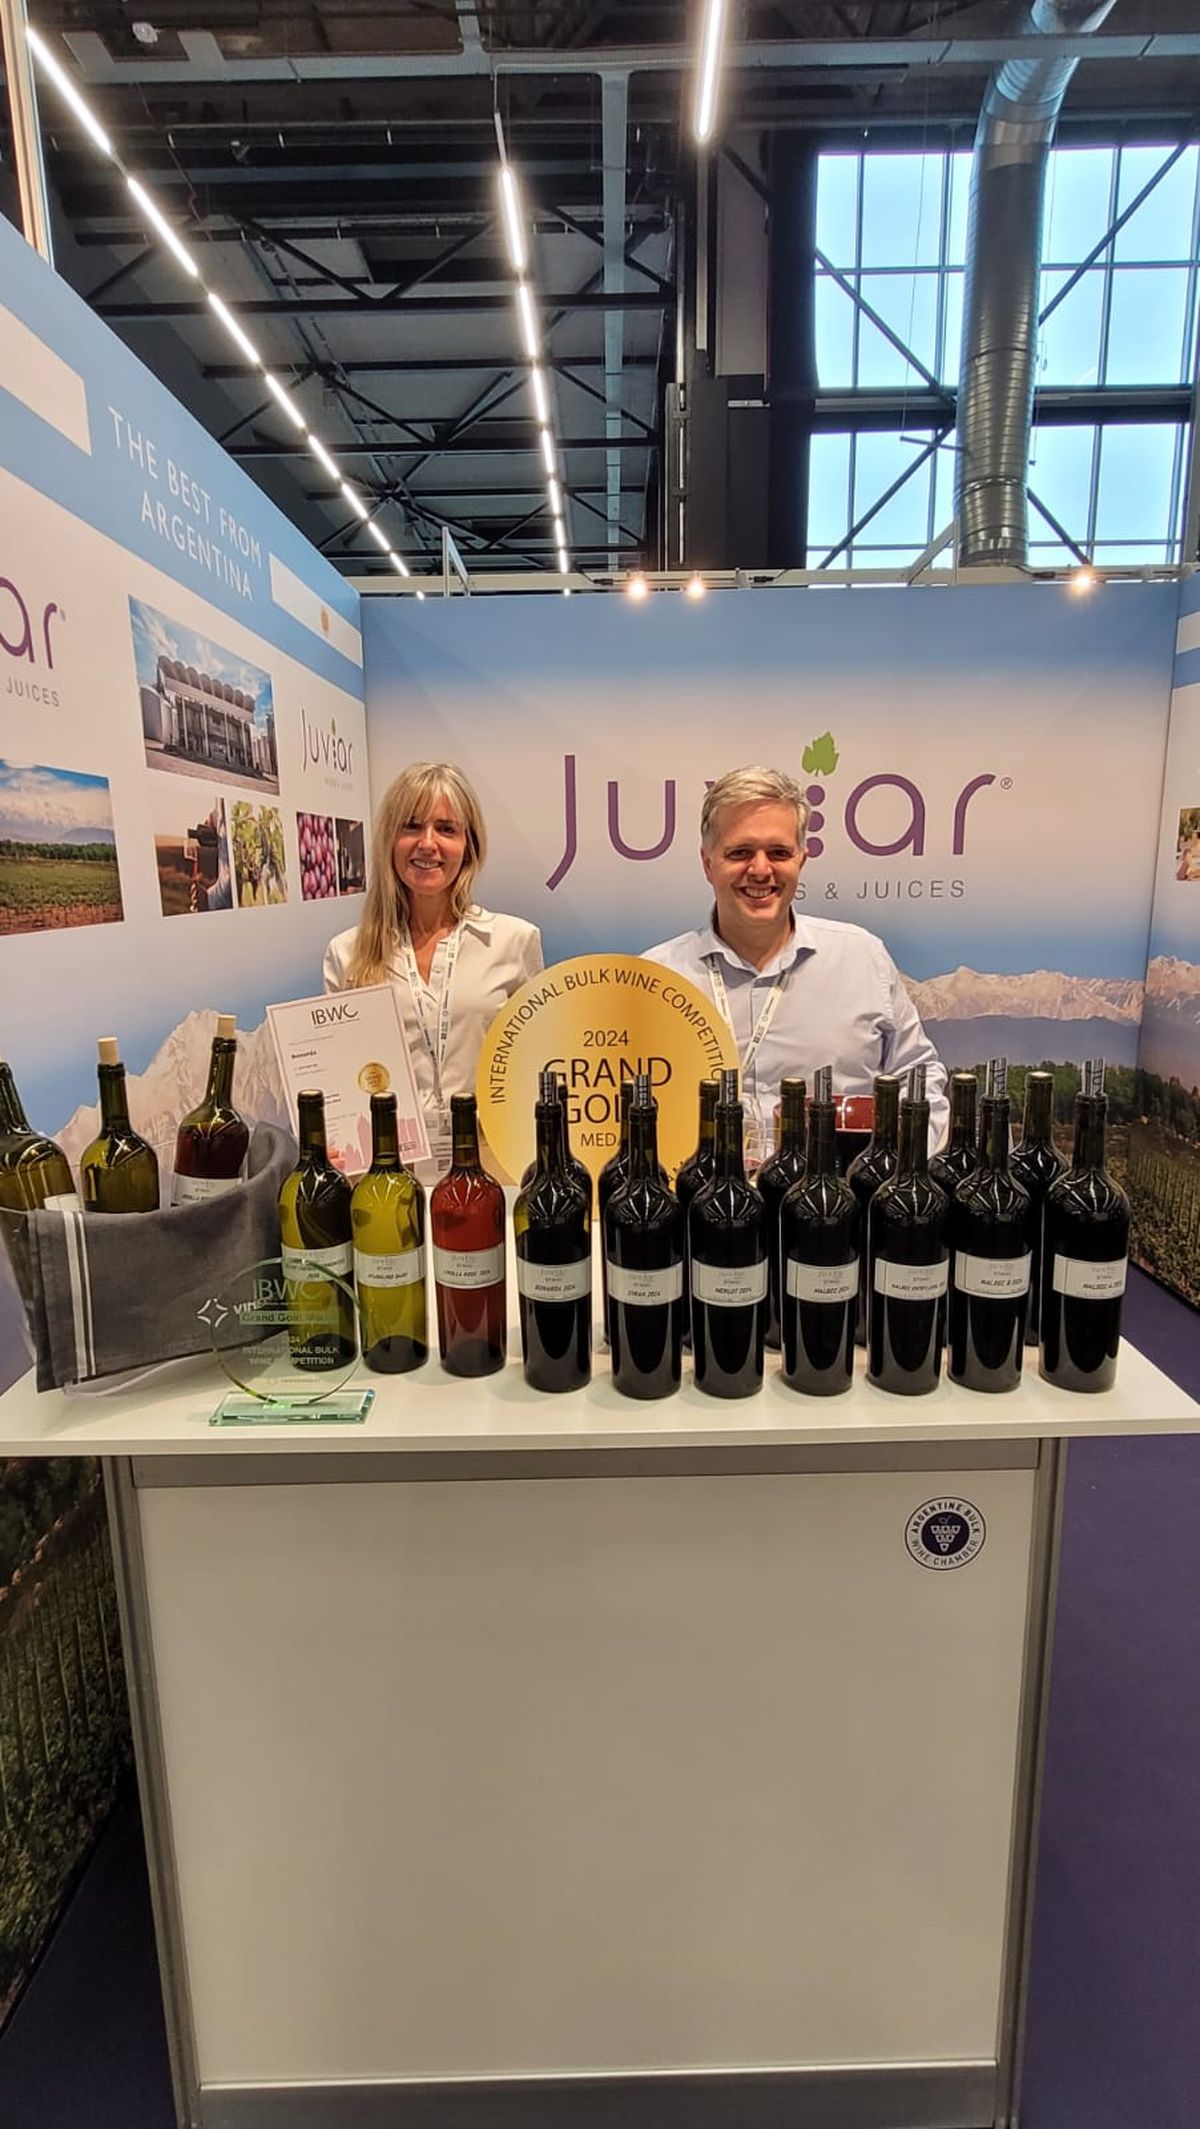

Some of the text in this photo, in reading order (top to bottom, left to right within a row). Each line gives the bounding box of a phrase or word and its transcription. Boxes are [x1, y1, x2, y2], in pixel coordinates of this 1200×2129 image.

[108, 406, 262, 569] THE BEST FROM
[142, 491, 253, 601] ARGENTINA
[6, 677, 60, 707] JUICES
[301, 708, 353, 775] Juviar
[857, 879, 965, 899] JUICES
[311, 1003, 360, 1026] IBWC
[490, 983, 563, 1104] INTERNATIONAL
[564, 968, 610, 991] BULK
[614, 968, 662, 994] WINE
[661, 986, 725, 1080] COMPETITIO
[583, 1030, 629, 1047] 2024
[544, 1057, 673, 1089] GRAND
[580, 1133, 620, 1147] MED
[254, 1278, 322, 1301] IBWC
[911, 1502, 980, 1534] ARGENTINE BULK
[911, 1539, 979, 1566] WINE CHAMBER
